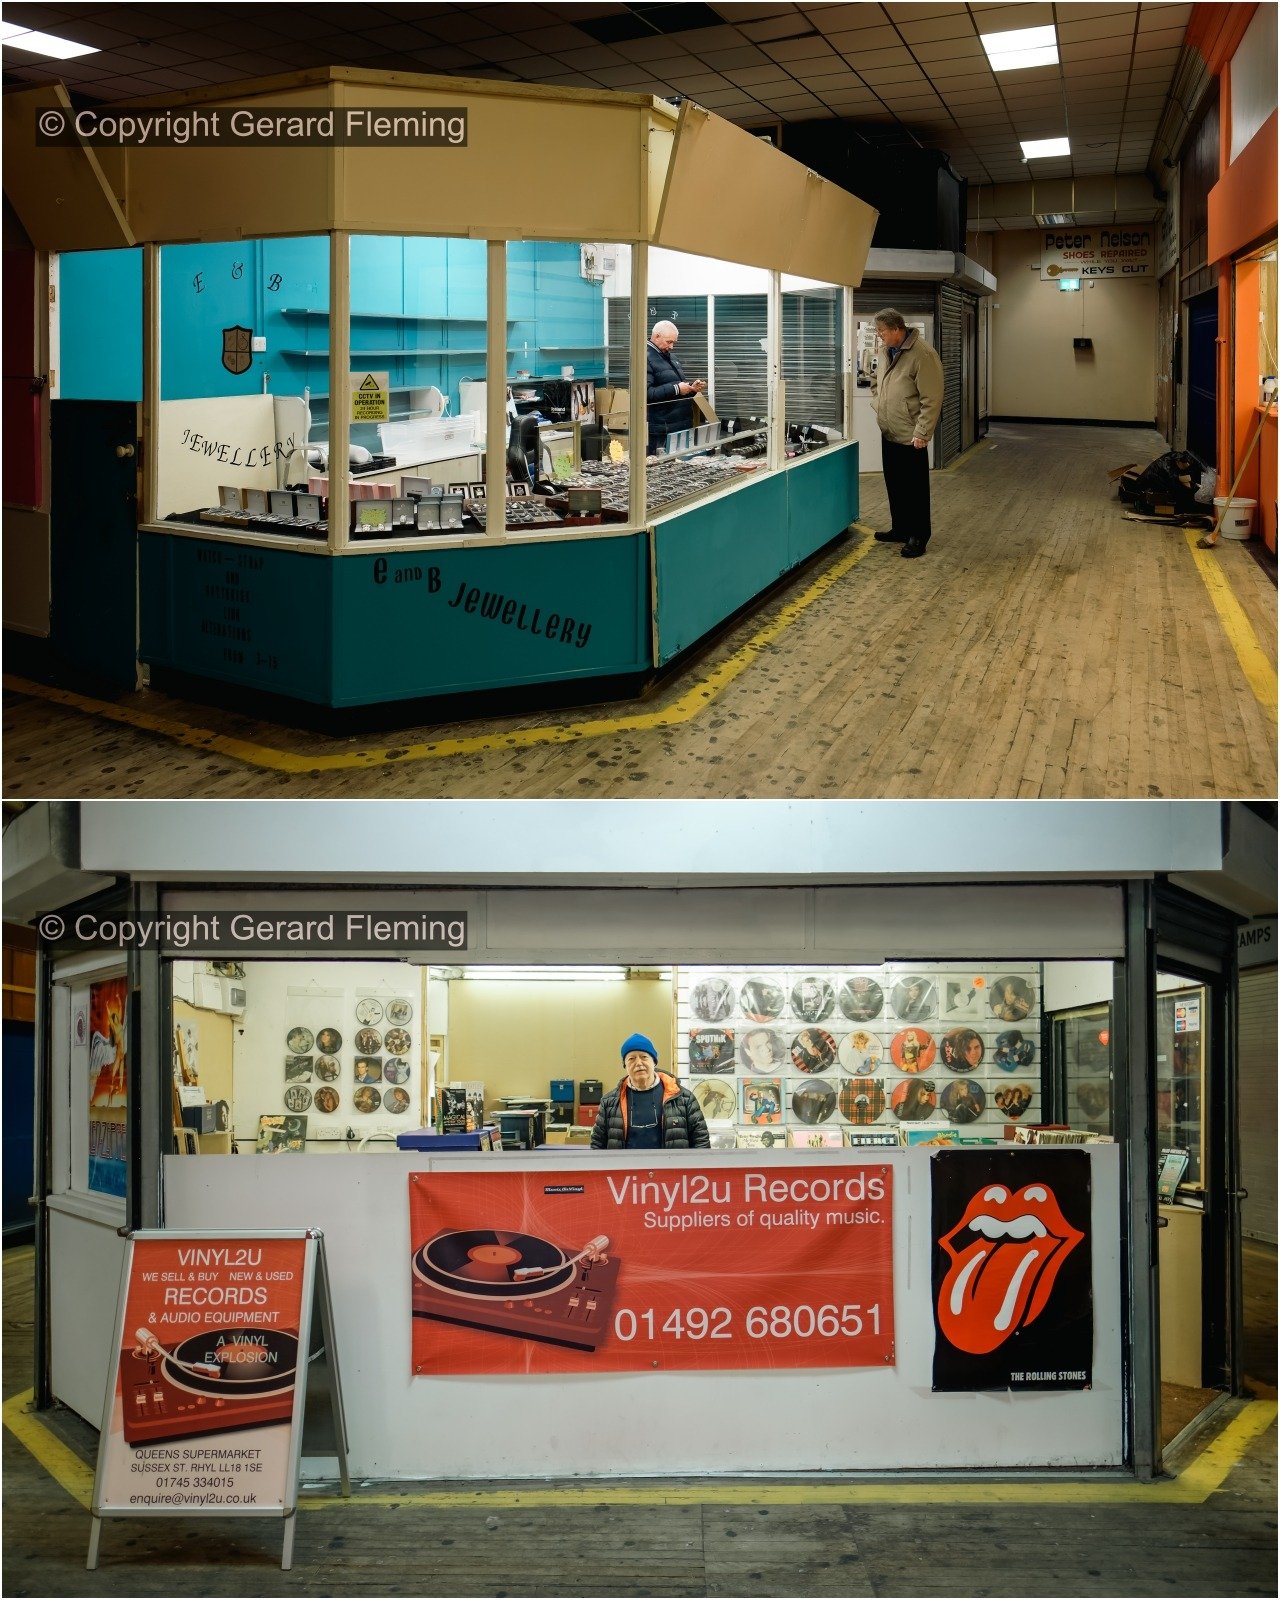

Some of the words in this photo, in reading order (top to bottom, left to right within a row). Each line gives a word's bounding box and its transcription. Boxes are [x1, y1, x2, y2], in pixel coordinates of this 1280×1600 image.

[1045, 232, 1092, 250] Peter
[1100, 230, 1150, 248] Nelson
[1062, 251, 1095, 260] SHOES
[1101, 249, 1147, 258] REPAIRED
[1082, 266, 1115, 274] KEYS
[1121, 264, 1149, 273] CUT
[193, 271, 206, 293] E
[231, 261, 243, 280] &
[267, 273, 283, 292] B
[181, 429, 298, 468] JEWELLERY
[427, 566, 442, 593] B
[1238, 926, 1271, 948] AMPS
[607, 1175, 731, 1212] Vinyl2u
[744, 1172, 885, 1203] Records
[643, 1211, 731, 1232] Suppliers
[736, 1210, 754, 1227] of
[759, 1209, 820, 1230] quality
[826, 1209, 885, 1225] music.
[177, 1248, 263, 1266] VINYL2U
[142, 1272, 158, 1282] WE
[161, 1272, 186, 1282] SELL
[188, 1272, 195, 1281] &
[198, 1272, 219, 1281] BUY
[229, 1272, 254, 1281] NEW
[255, 1272, 263, 1280] &
[265, 1271, 294, 1281] USED
[164, 1287, 268, 1306] RECORDS
[148, 1312, 157, 1323] &
[160, 1312, 201, 1323] AUDIO
[204, 1311, 280, 1323] EQUIPMENT
[614, 1307, 733, 1341] 01492
[746, 1303, 880, 1339] 680651
[216, 1336, 226, 1347] A
[232, 1335, 269, 1347] VINYL
[204, 1352, 278, 1363] EXPLOSION
[1010, 1372, 1024, 1381] THE
[1025, 1371, 1057, 1381] ROLLING
[1058, 1371, 1087, 1380] STONES
[135, 1449, 180, 1460] QUEENS
[182, 1449, 262, 1460] SUPERMARKET
[130, 1463, 170, 1473] SUSSEX
[173, 1463, 188, 1473] ST.
[190, 1463, 216, 1472] RHYL
[219, 1463, 241, 1472] LL18
[244, 1463, 263, 1472] 1SE
[156, 1477, 190, 1488] 01745
[192, 1477, 234, 1488] 334015
[130, 1493, 257, 1506] enquire@vinyl2u.co.uk
